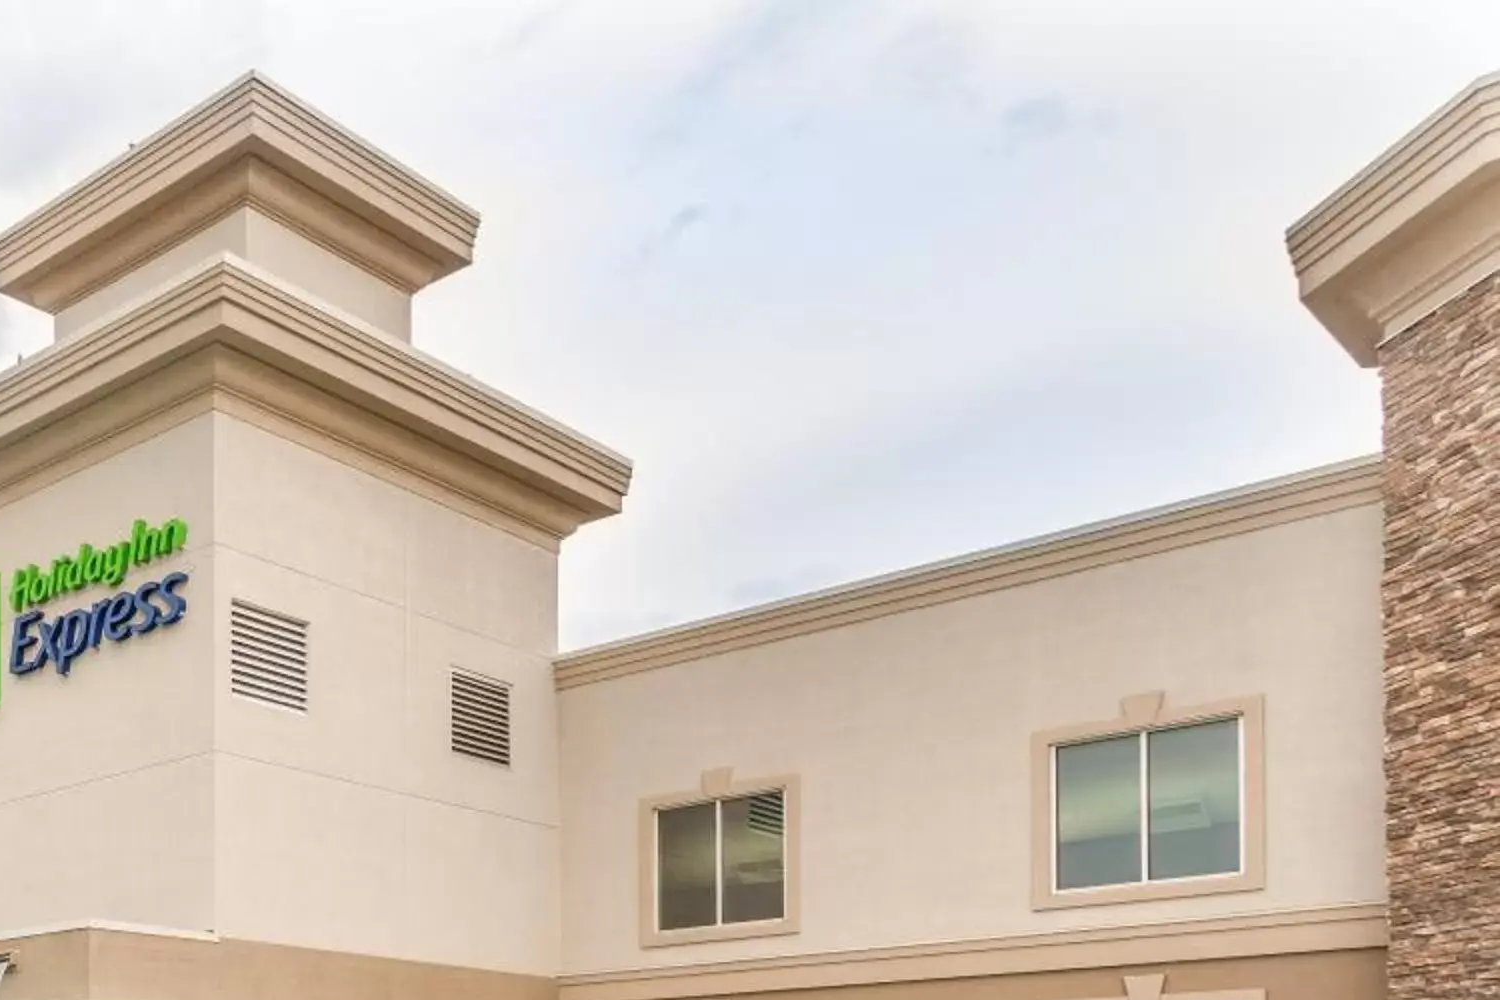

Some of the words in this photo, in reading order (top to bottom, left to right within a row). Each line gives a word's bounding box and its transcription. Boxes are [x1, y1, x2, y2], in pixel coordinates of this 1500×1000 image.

[9, 543, 132, 612] Holiday
[130, 518, 188, 567] Inn
[9, 571, 190, 677] Express
